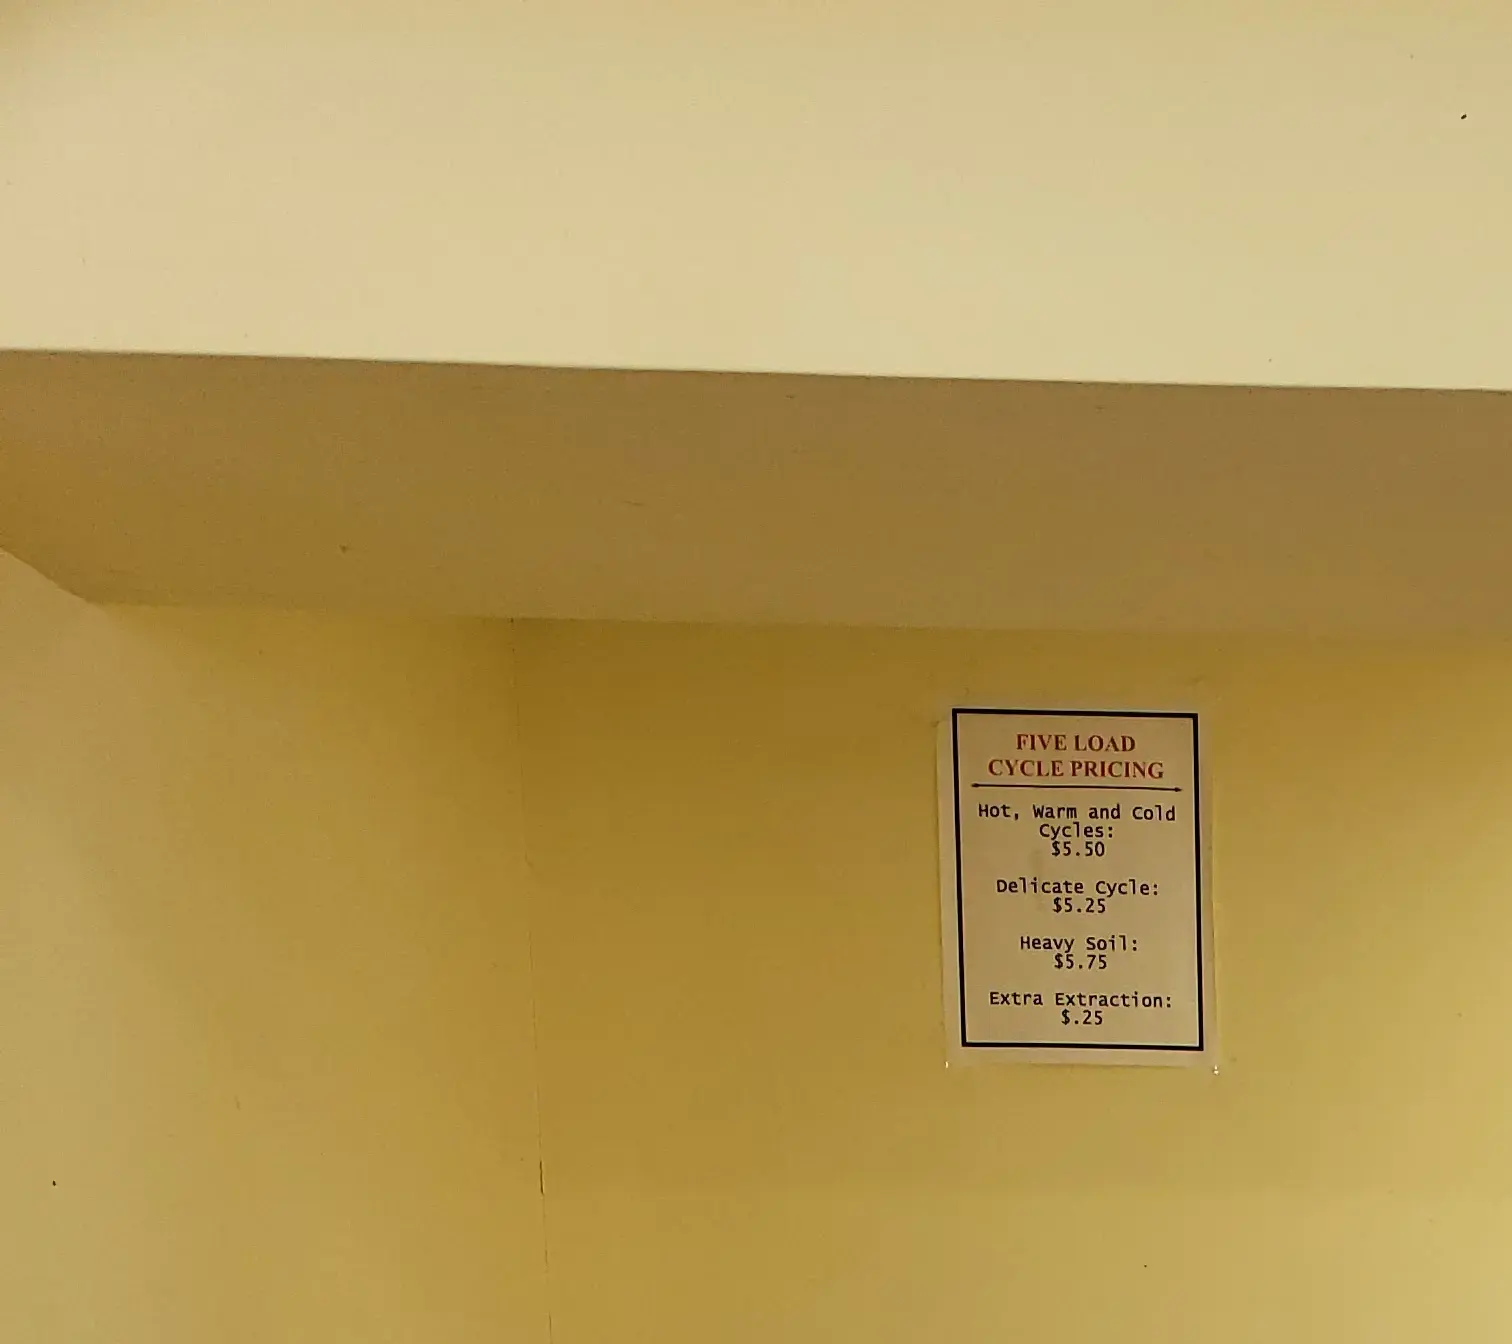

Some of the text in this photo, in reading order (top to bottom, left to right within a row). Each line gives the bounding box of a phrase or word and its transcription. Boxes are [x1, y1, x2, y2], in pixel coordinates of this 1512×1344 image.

[1016, 734, 1135, 751] FIVE LOAD
[988, 759, 1163, 779] CYCLE PRICING
[978, 802, 1175, 822] Hot, Warm and Cold
[1039, 822, 1114, 841] Cycles:
[1051, 840, 1104, 857] $5.50
[996, 877, 1159, 898] Delicate Cycle:
[1052, 897, 1105, 913] $5.25
[1020, 934, 1138, 953] Heavy Soil:
[1054, 953, 1106, 970] $5.75
[990, 990, 1172, 1010] Extra Extraction:
[1061, 1009, 1102, 1025] $.25
